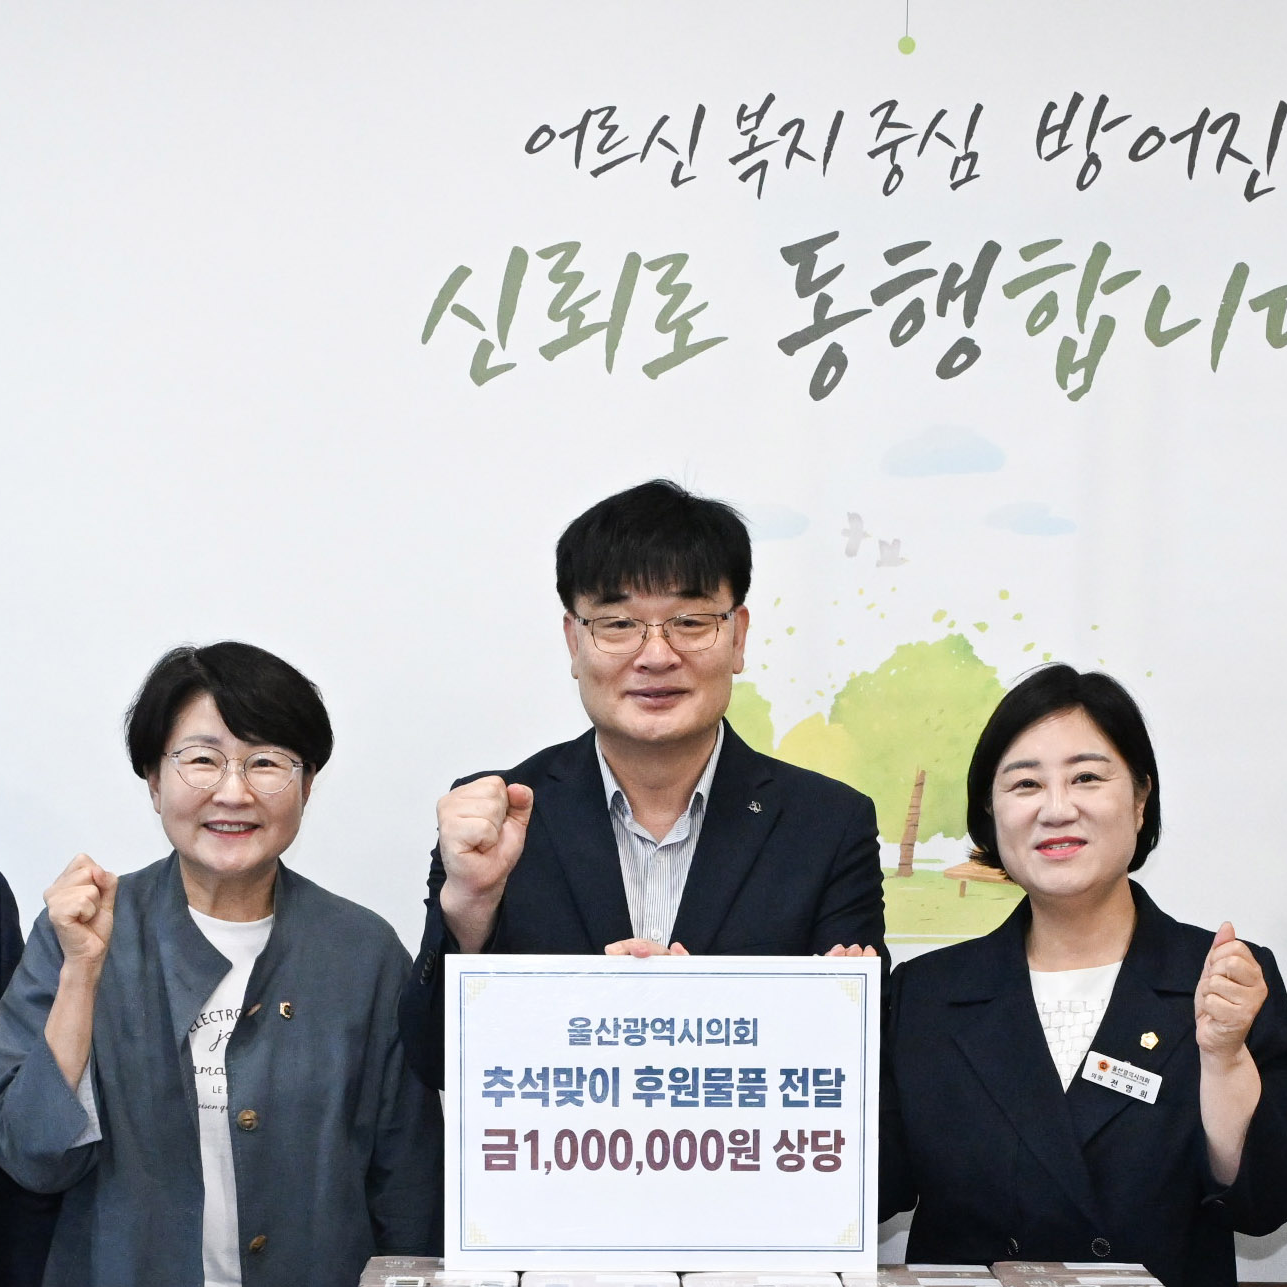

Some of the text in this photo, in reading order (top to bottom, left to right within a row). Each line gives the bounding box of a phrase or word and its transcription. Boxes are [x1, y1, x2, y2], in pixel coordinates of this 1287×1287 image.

[524, 103, 706, 188] 어르신
[731, 93, 845, 199] 복지
[867, 99, 984, 197] 중심
[421, 240, 729, 386] 신뢰로
[567, 1017, 759, 1047] 울산광역시의회
[482, 1066, 845, 1108] 추석맞이 후원물품 전달
[482, 1128, 845, 1175] 금1,000,000원 상당
